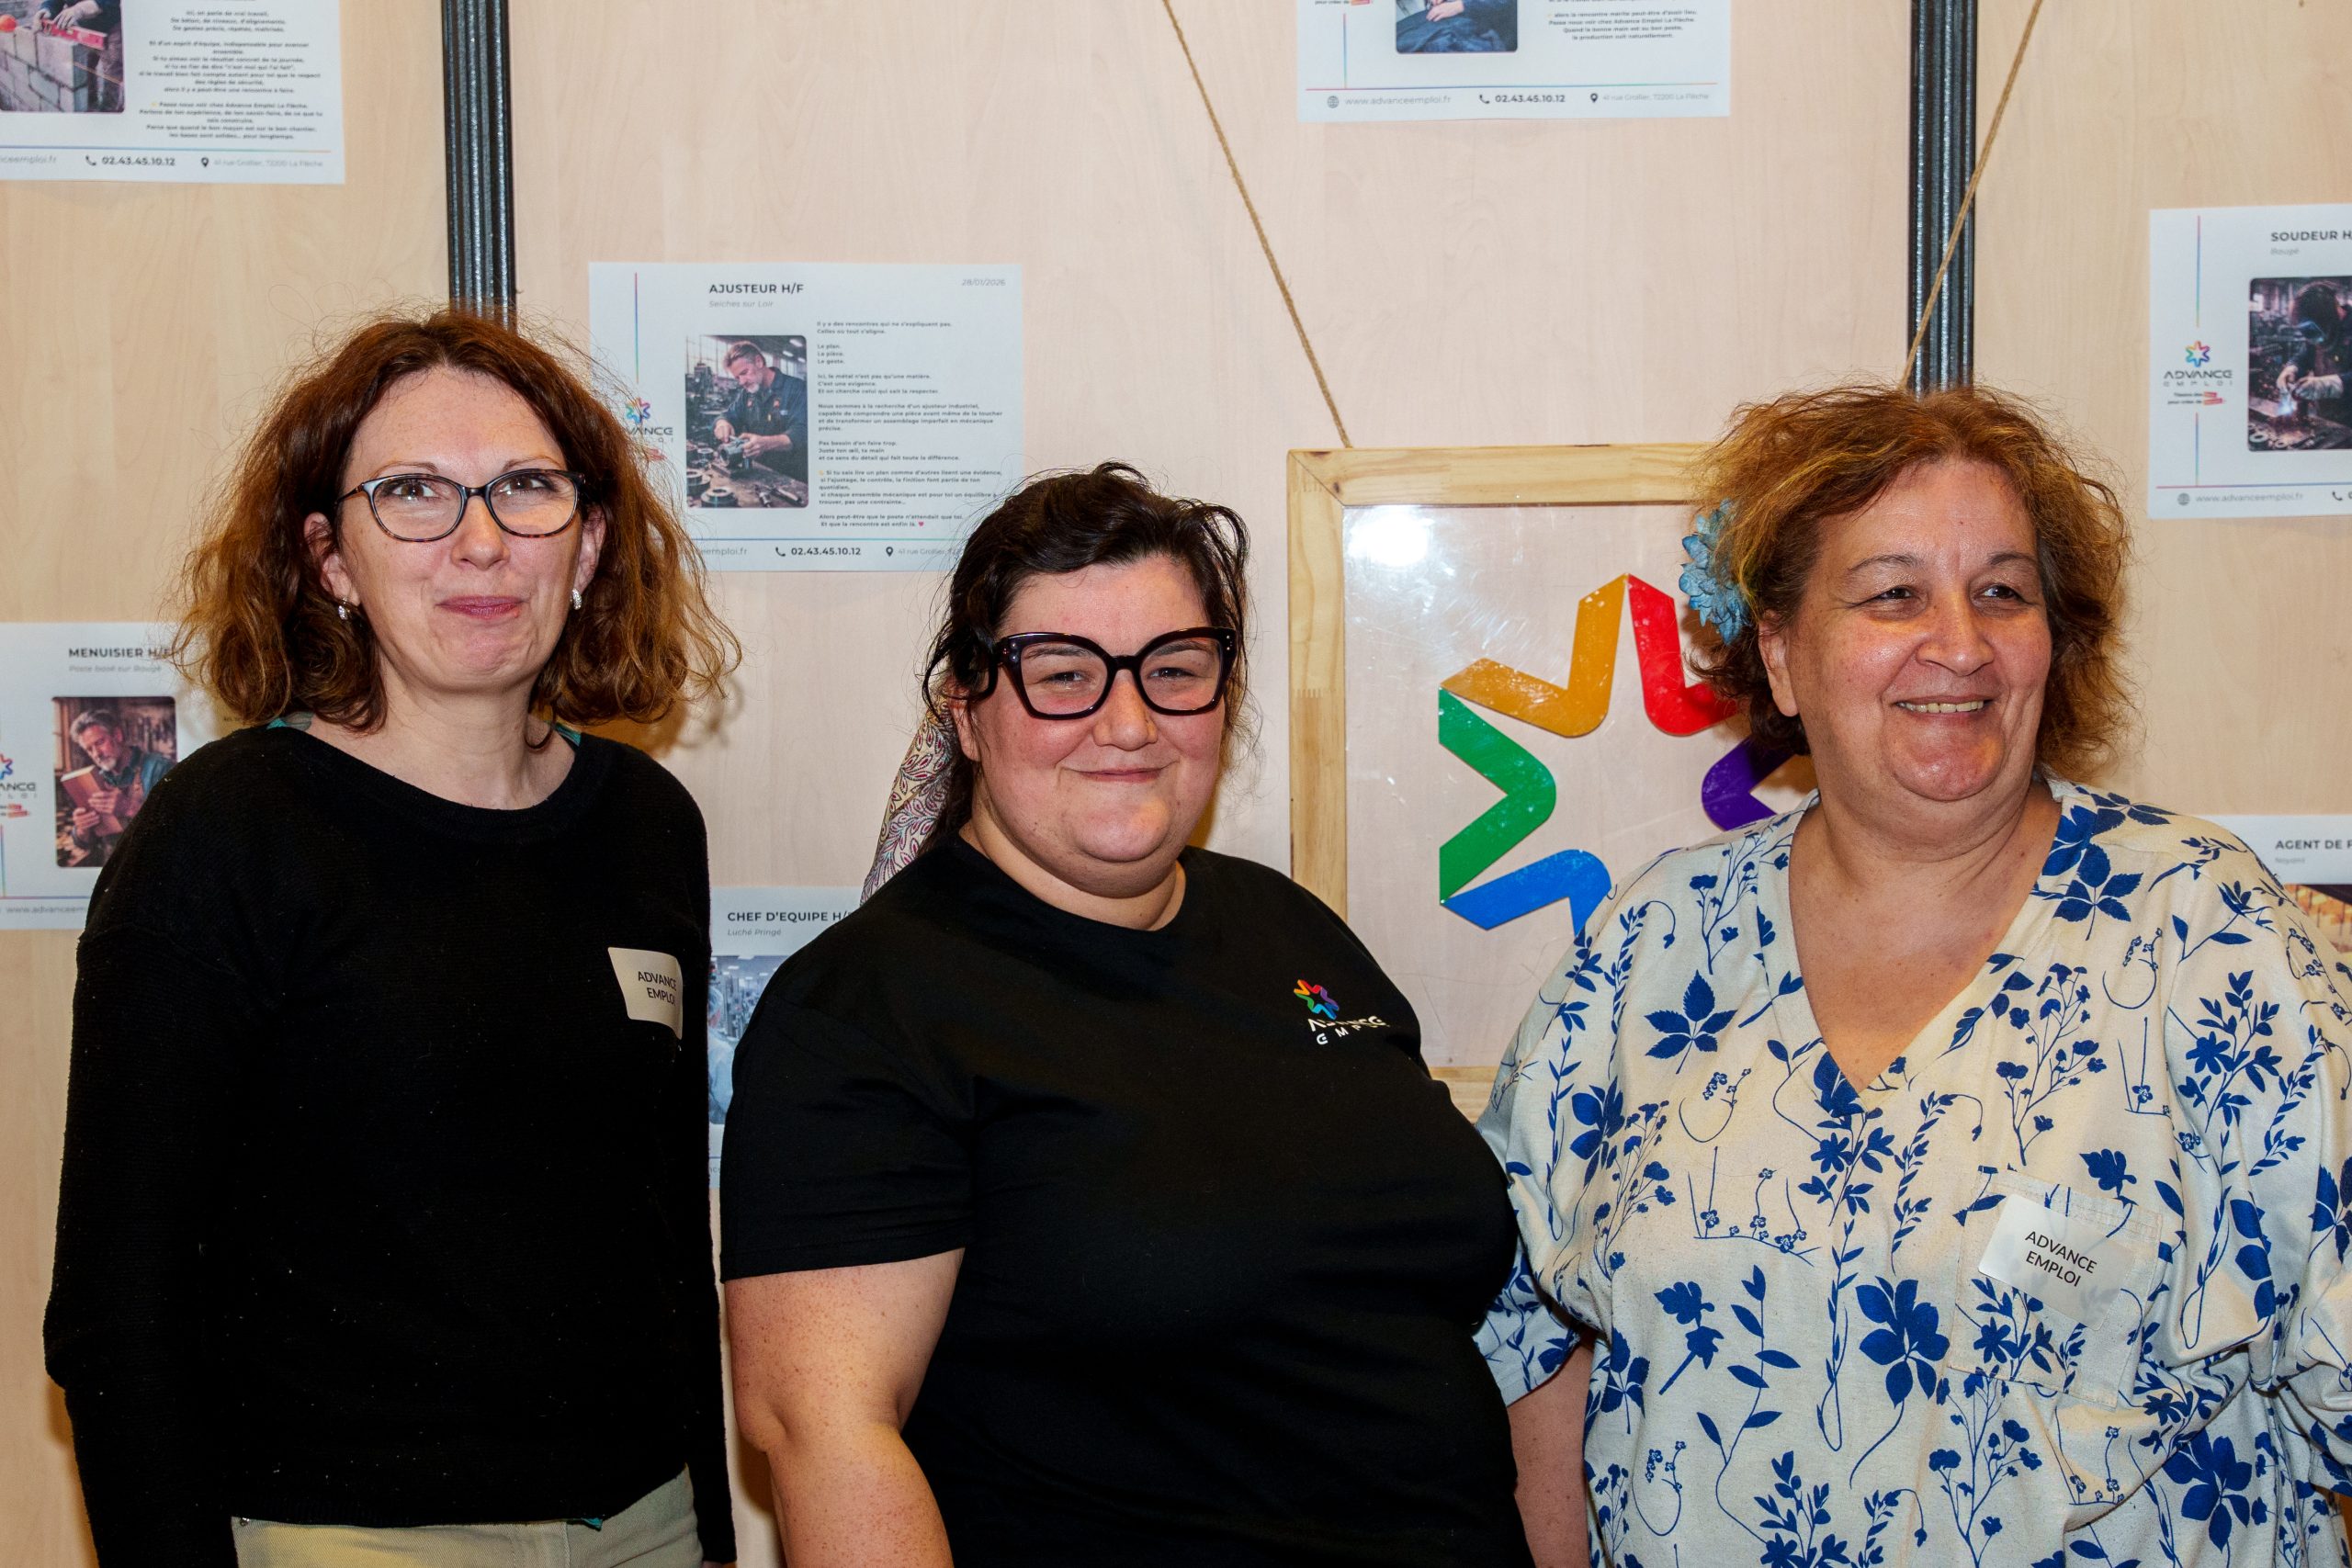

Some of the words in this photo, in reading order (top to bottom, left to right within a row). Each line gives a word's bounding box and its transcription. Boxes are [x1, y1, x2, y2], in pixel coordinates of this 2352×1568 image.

[1495, 94, 1565, 104] 02.43.45.10.12
[102, 155, 175, 166] 02.43.45.10.12
[2271, 231, 2338, 242] SOUDEUR
[2343, 230, 2352, 240] H
[961, 278, 1005, 287] 28/01/2026
[709, 284, 777, 293] AJUSTEUR
[781, 283, 804, 294] H/F
[2164, 370, 2232, 379] ADVANCE
[791, 547, 861, 556] 02.43.45.10.12
[69, 648, 143, 658] MENUISIER
[2275, 840, 2320, 850] AGENT
[2325, 840, 2342, 849] DE
[728, 912, 762, 921] CHEF
[767, 912, 827, 923] D'EQUIPE
[833, 912, 851, 921] H/
[728, 926, 752, 936] Luché
[755, 926, 781, 937] Pringé
[638, 971, 677, 991] ADVANCE
[2025, 1231, 2097, 1274] ADVANCE
[2026, 1251, 2081, 1287] EMPLOI
